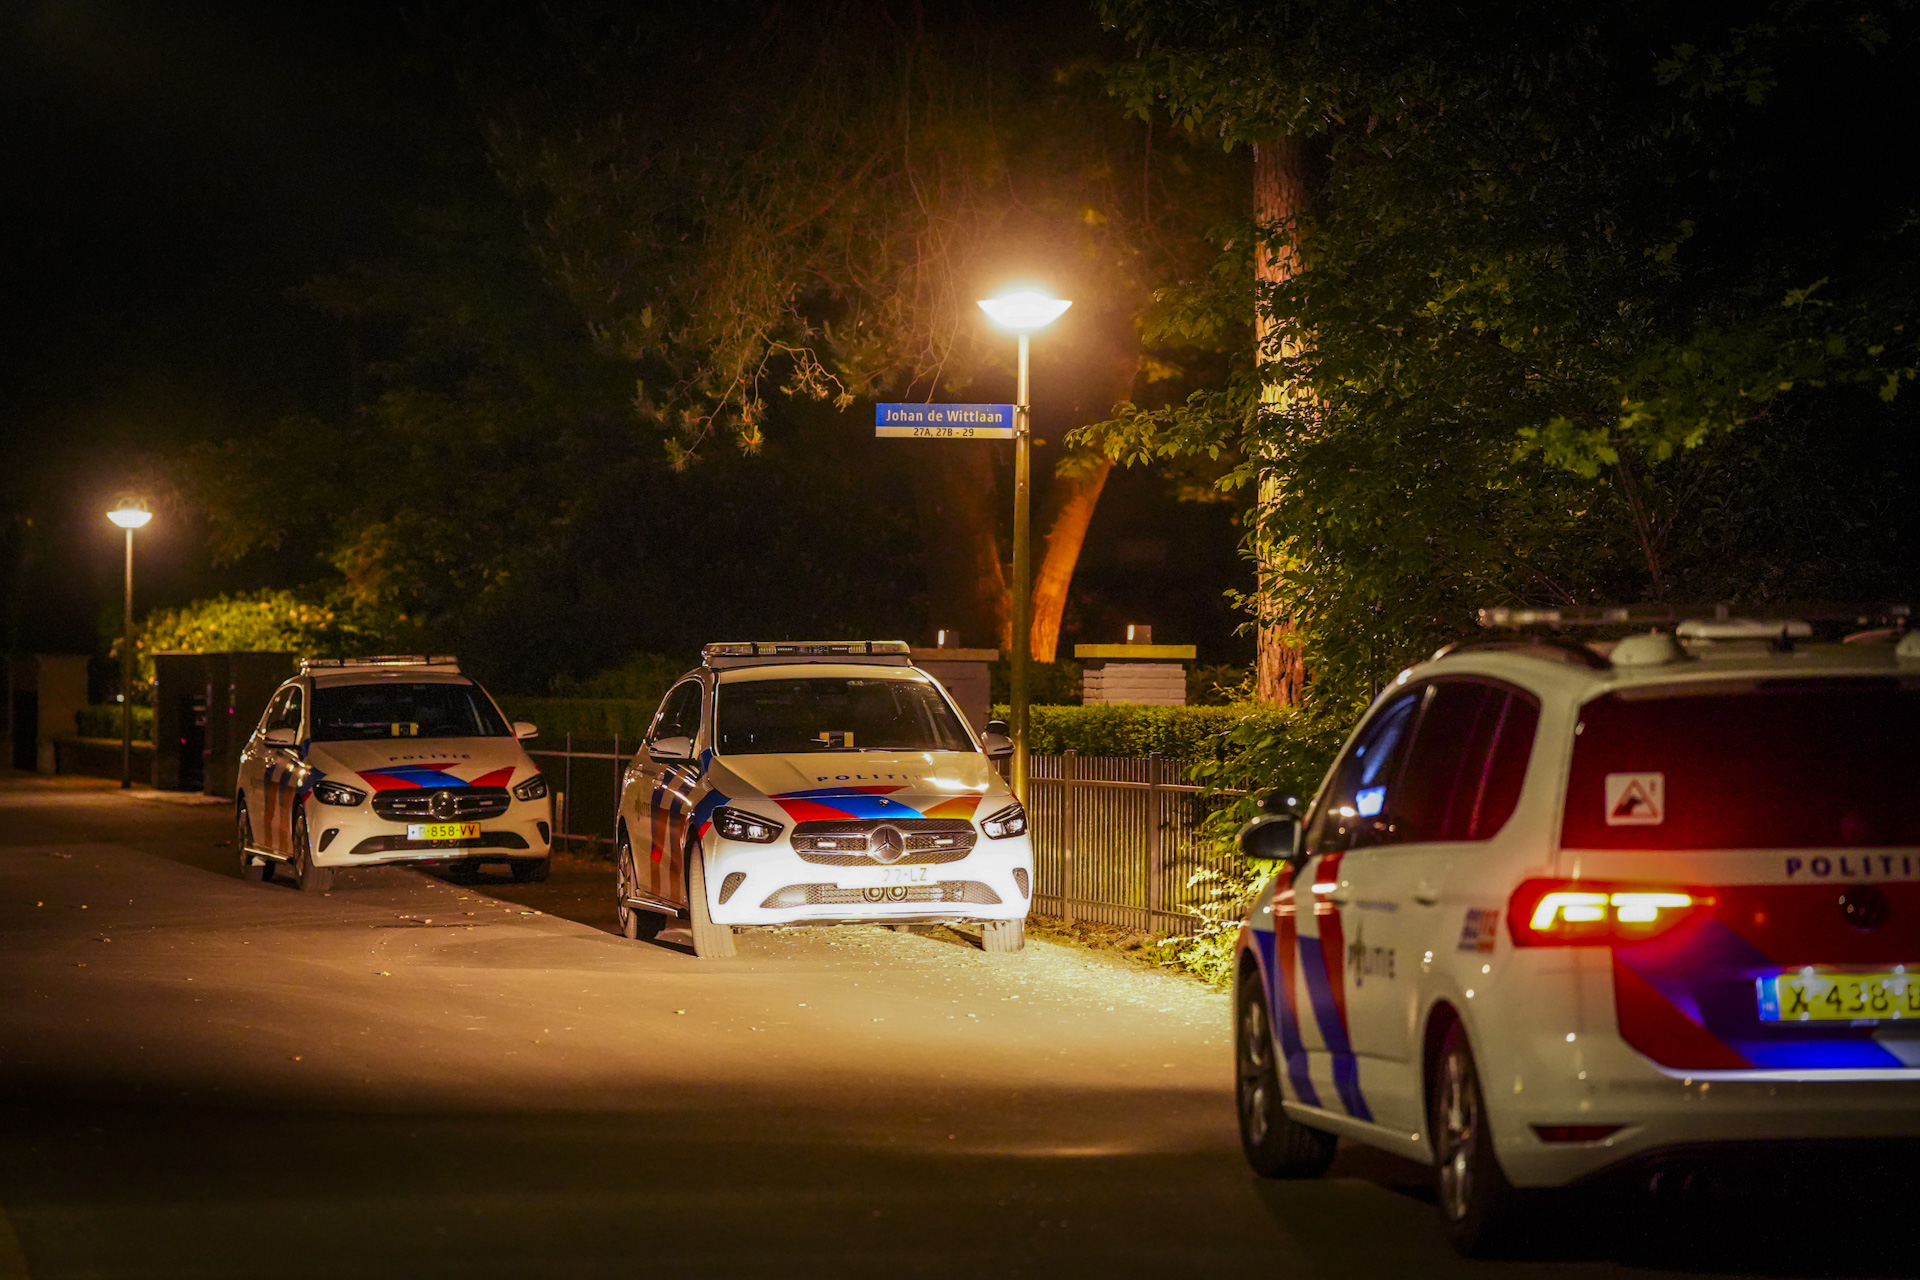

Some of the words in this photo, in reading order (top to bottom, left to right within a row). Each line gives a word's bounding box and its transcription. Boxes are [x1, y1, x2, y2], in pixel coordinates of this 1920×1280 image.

[886, 409, 923, 422] Johan
[927, 409, 943, 422] de
[946, 410, 1003, 423] Wittlaan
[913, 427, 933, 438] 27A,
[936, 428, 953, 437] 27B
[962, 428, 975, 437] 29
[1786, 855, 1920, 878] POLITI
